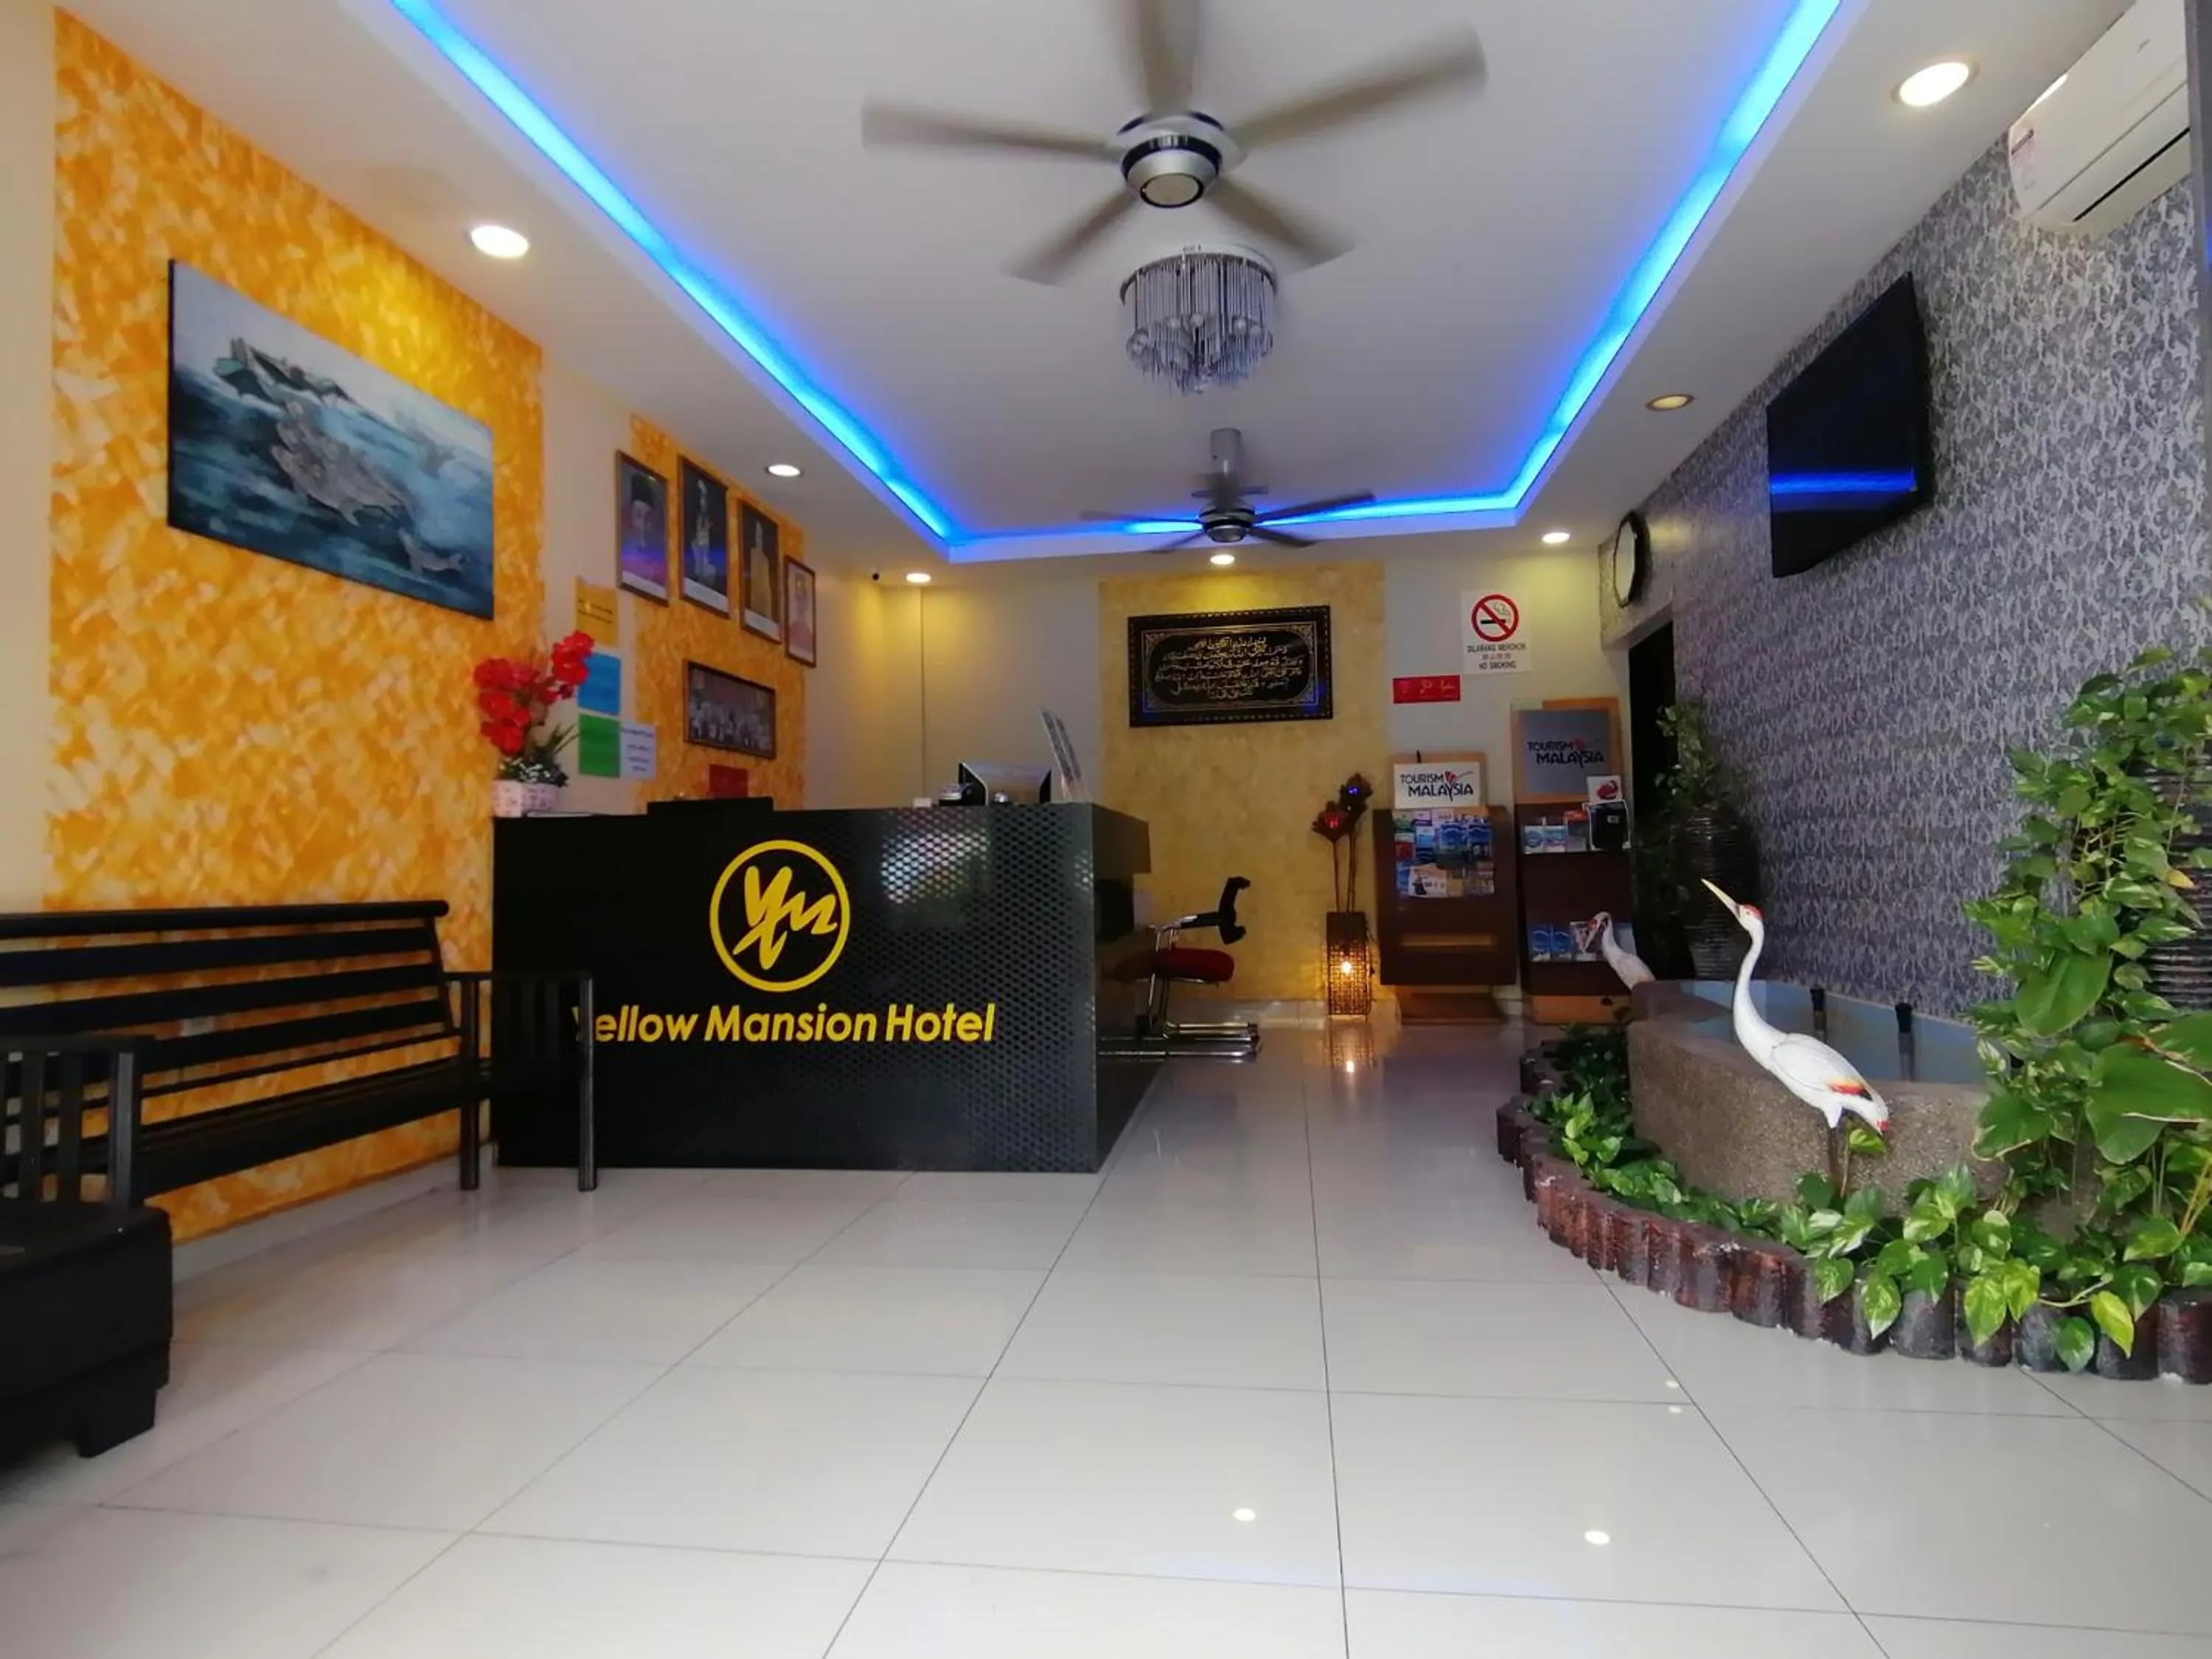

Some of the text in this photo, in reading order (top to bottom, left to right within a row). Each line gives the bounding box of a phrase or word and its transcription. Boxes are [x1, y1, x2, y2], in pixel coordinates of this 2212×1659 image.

[1527, 740, 1573, 751] TOURISM
[1536, 750, 1604, 769] MALAYSIA
[1399, 773, 1444, 785] TOURISM
[1408, 782, 1474, 802] MALAYSIA
[703, 1002, 878, 1043] Mansion
[885, 1002, 995, 1042] Hotel
